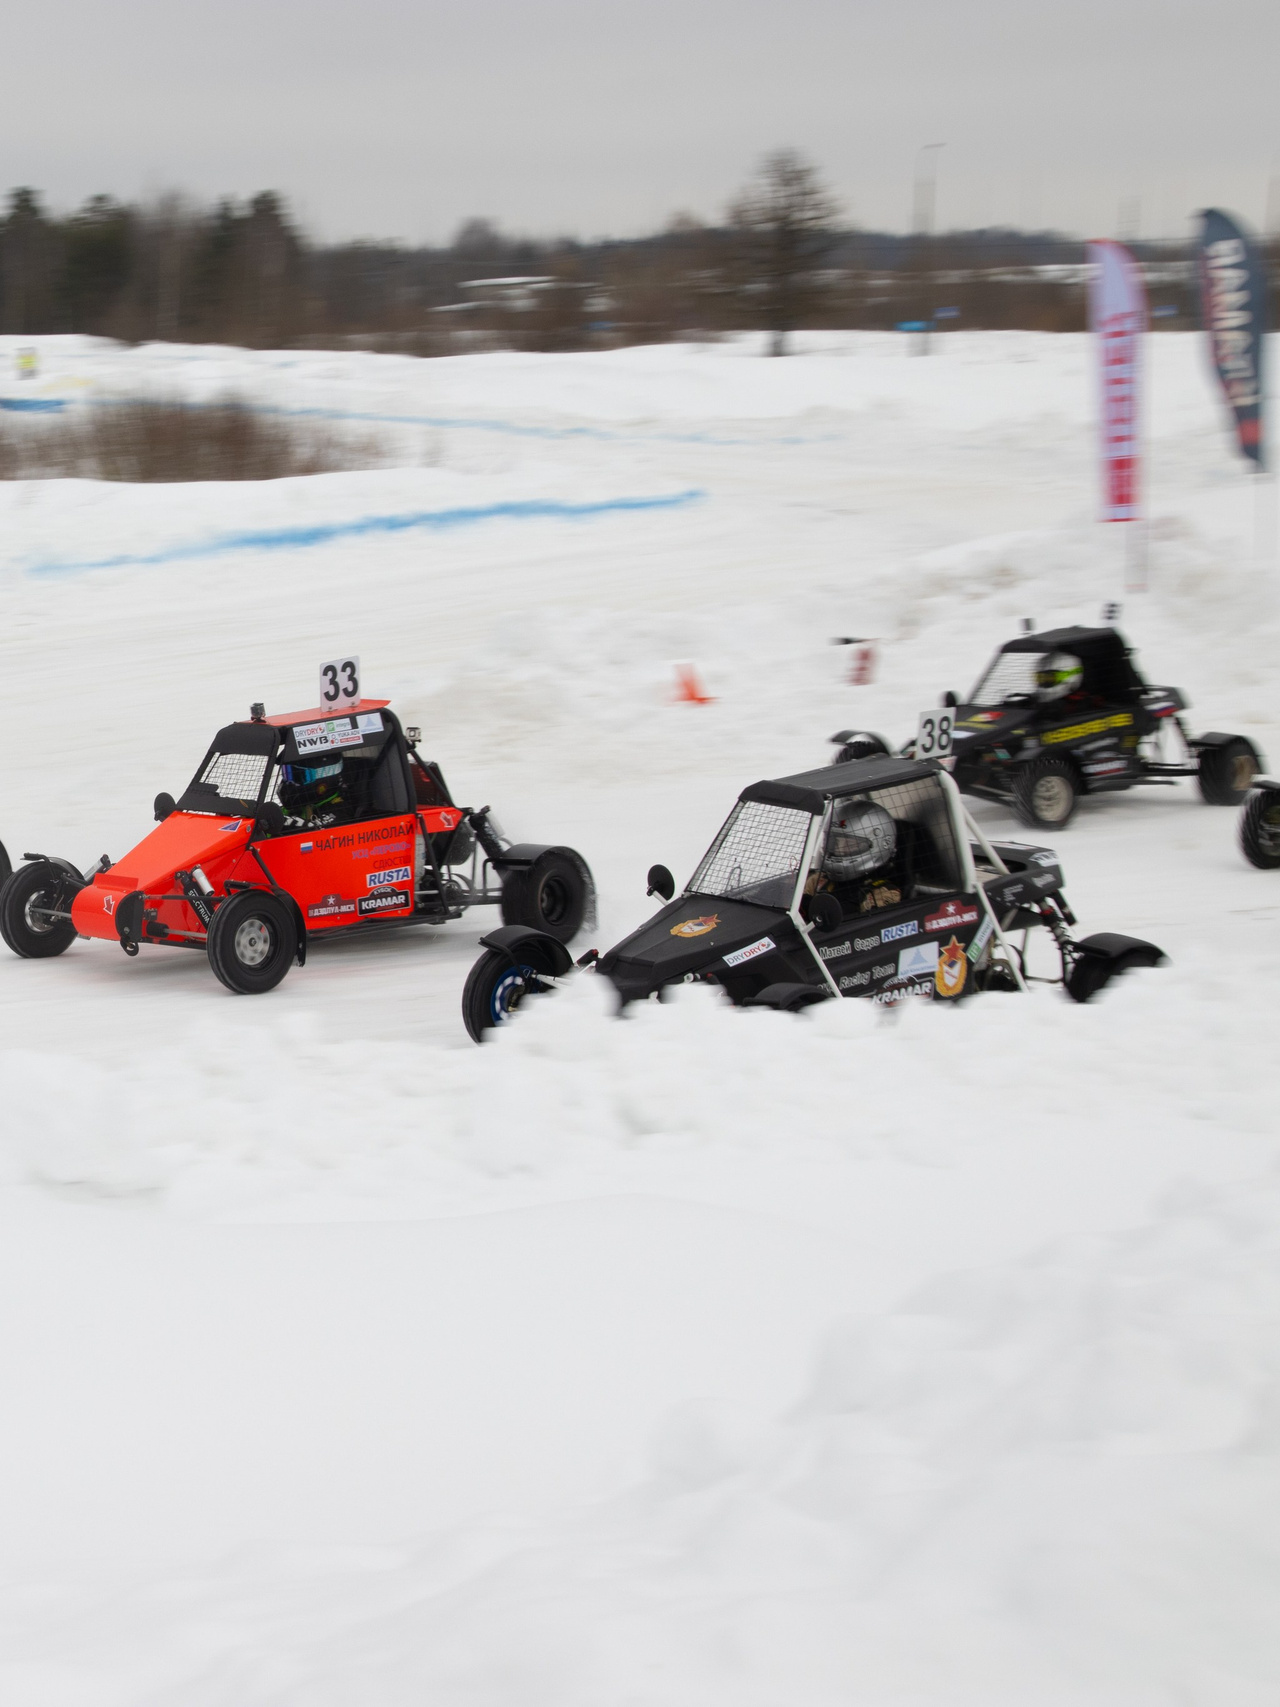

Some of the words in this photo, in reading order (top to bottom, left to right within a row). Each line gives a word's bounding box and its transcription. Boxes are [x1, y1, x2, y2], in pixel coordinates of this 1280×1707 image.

[322, 661, 359, 702] 33
[297, 736, 329, 749] NWB
[922, 716, 951, 753] 38
[315, 833, 355, 851] ЧАГИН
[358, 821, 414, 845] НИКОЛАЙ
[368, 867, 410, 887] RUSTA
[188, 890, 209, 924] SCTRUM
[361, 895, 406, 910] KRAMAR
[883, 922, 918, 941] RUSTA
[727, 945, 762, 964] DRYDRY
[820, 941, 852, 960] Матвей
[853, 936, 881, 951] Седов
[839, 971, 871, 990] Racing
[872, 963, 896, 980] Team
[872, 981, 932, 1005] KRAMAR
